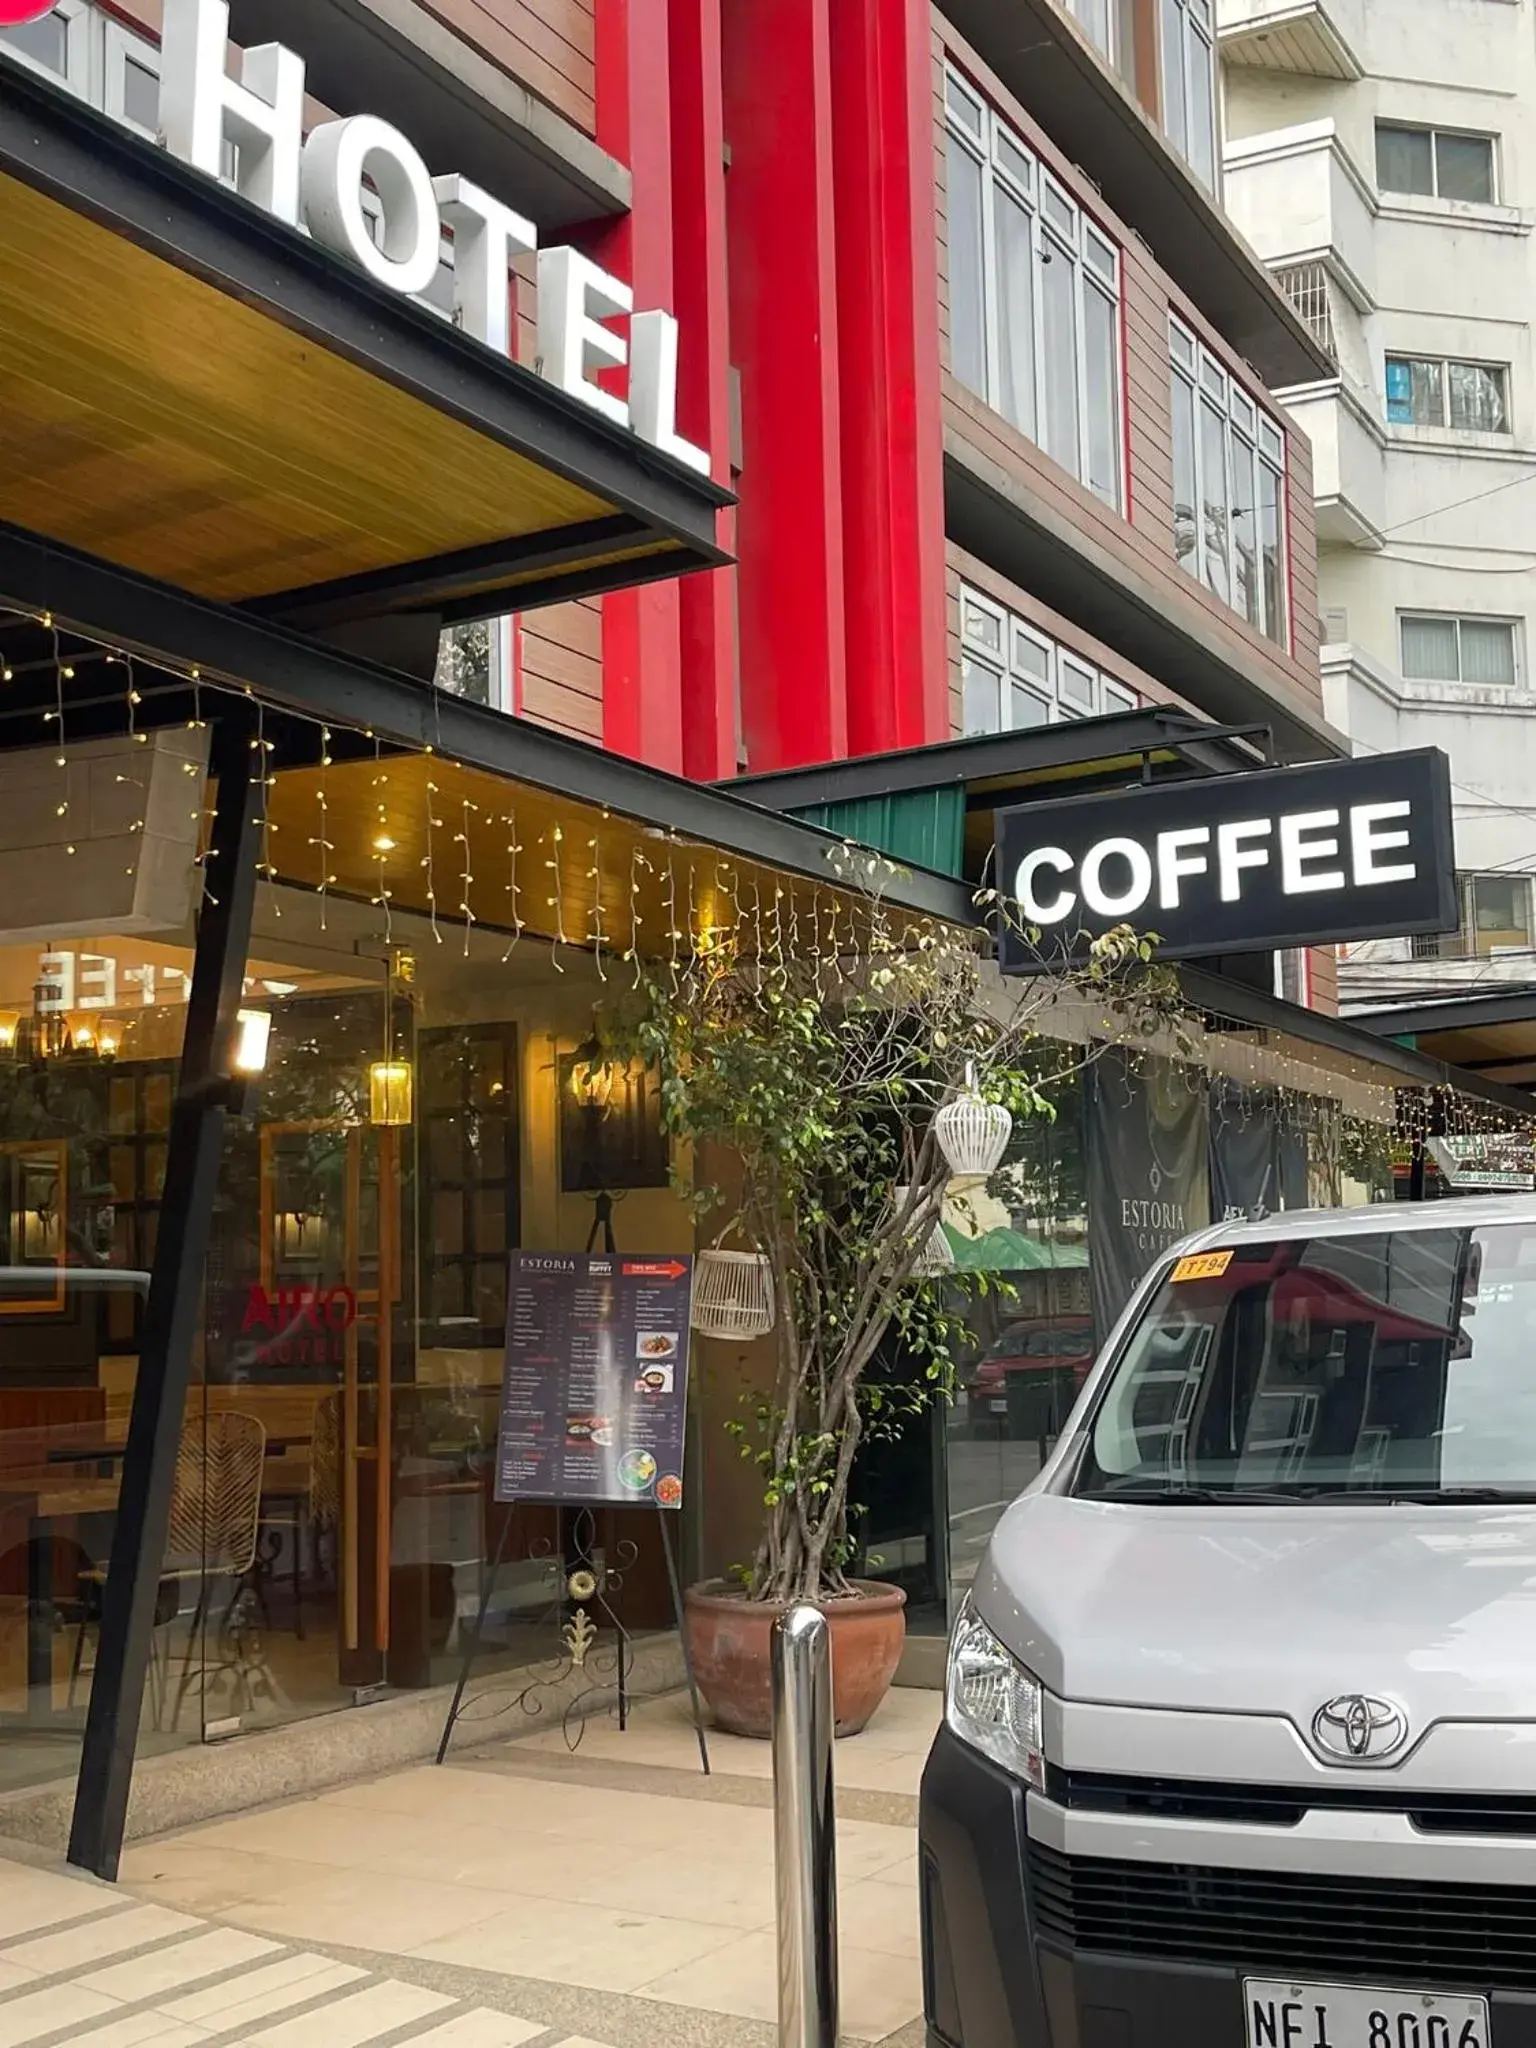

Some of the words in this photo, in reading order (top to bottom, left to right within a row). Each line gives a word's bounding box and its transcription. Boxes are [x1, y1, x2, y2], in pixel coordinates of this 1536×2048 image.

[158, 0, 711, 476] HOTEL
[1014, 800, 1416, 925] COFFEE
[1121, 1199, 1185, 1230] ESTORIA
[519, 1258, 576, 1270] ESTORIA
[240, 1280, 358, 1335] AIRO
